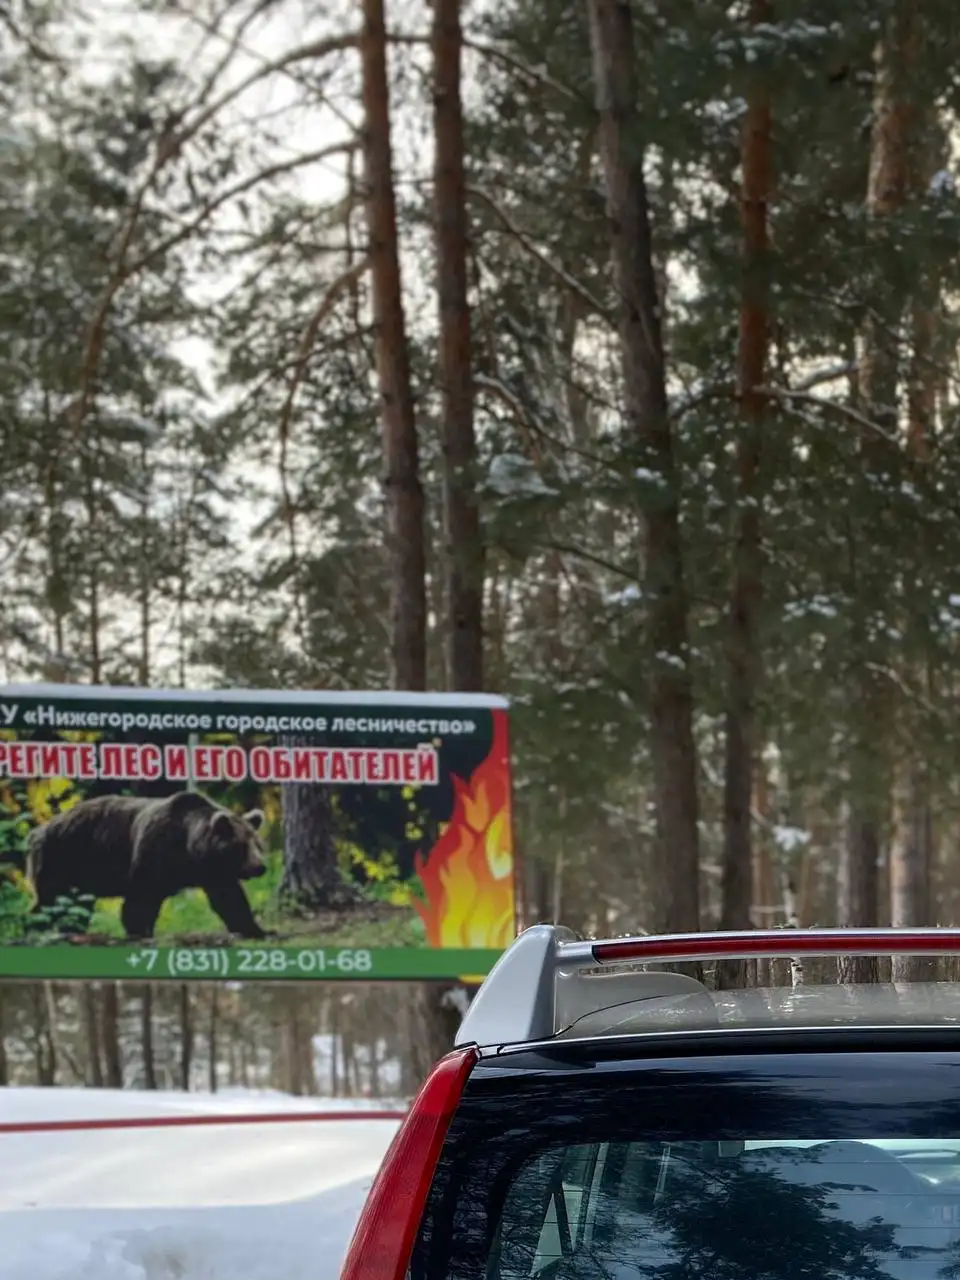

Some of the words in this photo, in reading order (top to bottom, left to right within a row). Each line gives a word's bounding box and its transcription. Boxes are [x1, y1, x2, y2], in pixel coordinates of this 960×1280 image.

[22, 704, 212, 732] «Нижегородское
[216, 715, 328, 733] городское
[331, 717, 476, 734] лесничество»
[100, 743, 161, 780] ЛЕС
[165, 745, 188, 780] И
[192, 745, 247, 781] ЕГО
[251, 743, 439, 785] ОБИТАТЕЛЕЙ
[126, 949, 158, 972] +7
[167, 949, 229, 976] (831)
[237, 949, 372, 972] 228-01-68
